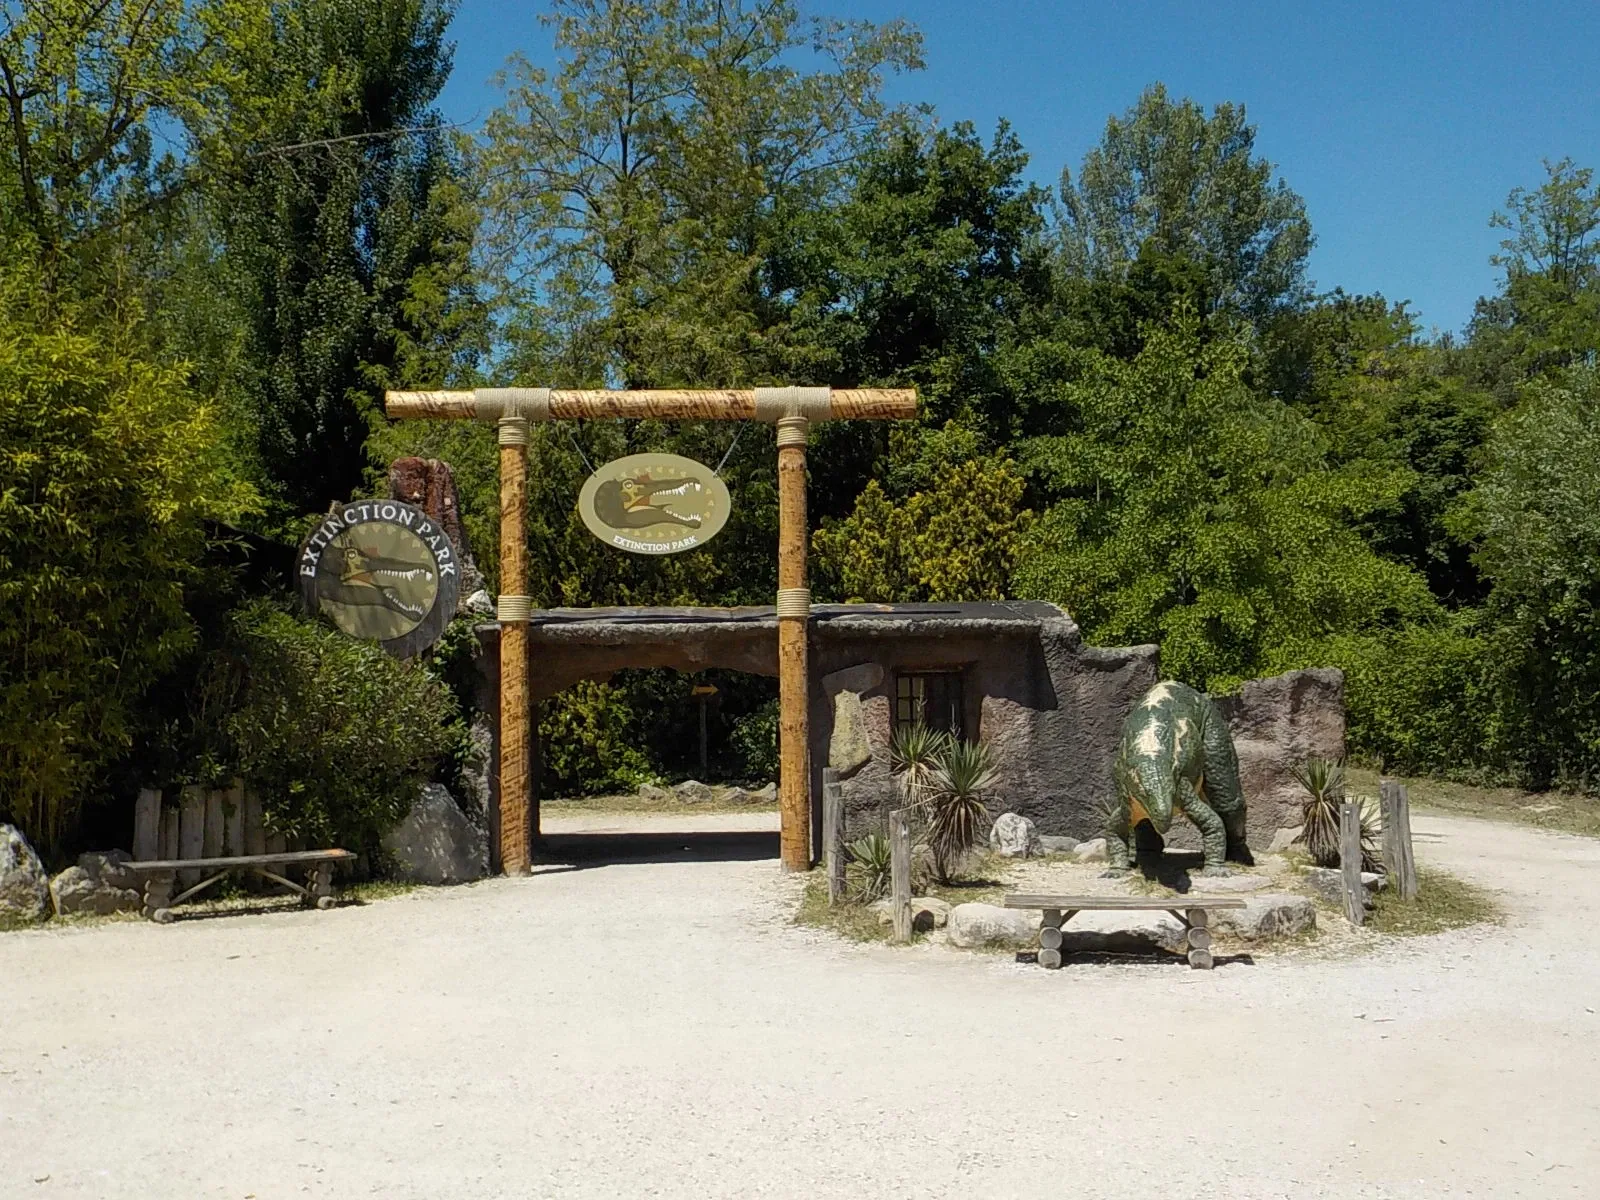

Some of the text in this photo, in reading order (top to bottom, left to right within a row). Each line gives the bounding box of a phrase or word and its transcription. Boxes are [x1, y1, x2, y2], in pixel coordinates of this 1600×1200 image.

[300, 505, 455, 578] EXTINCTION PARK
[613, 535, 697, 551] EXTINCTION PARK
